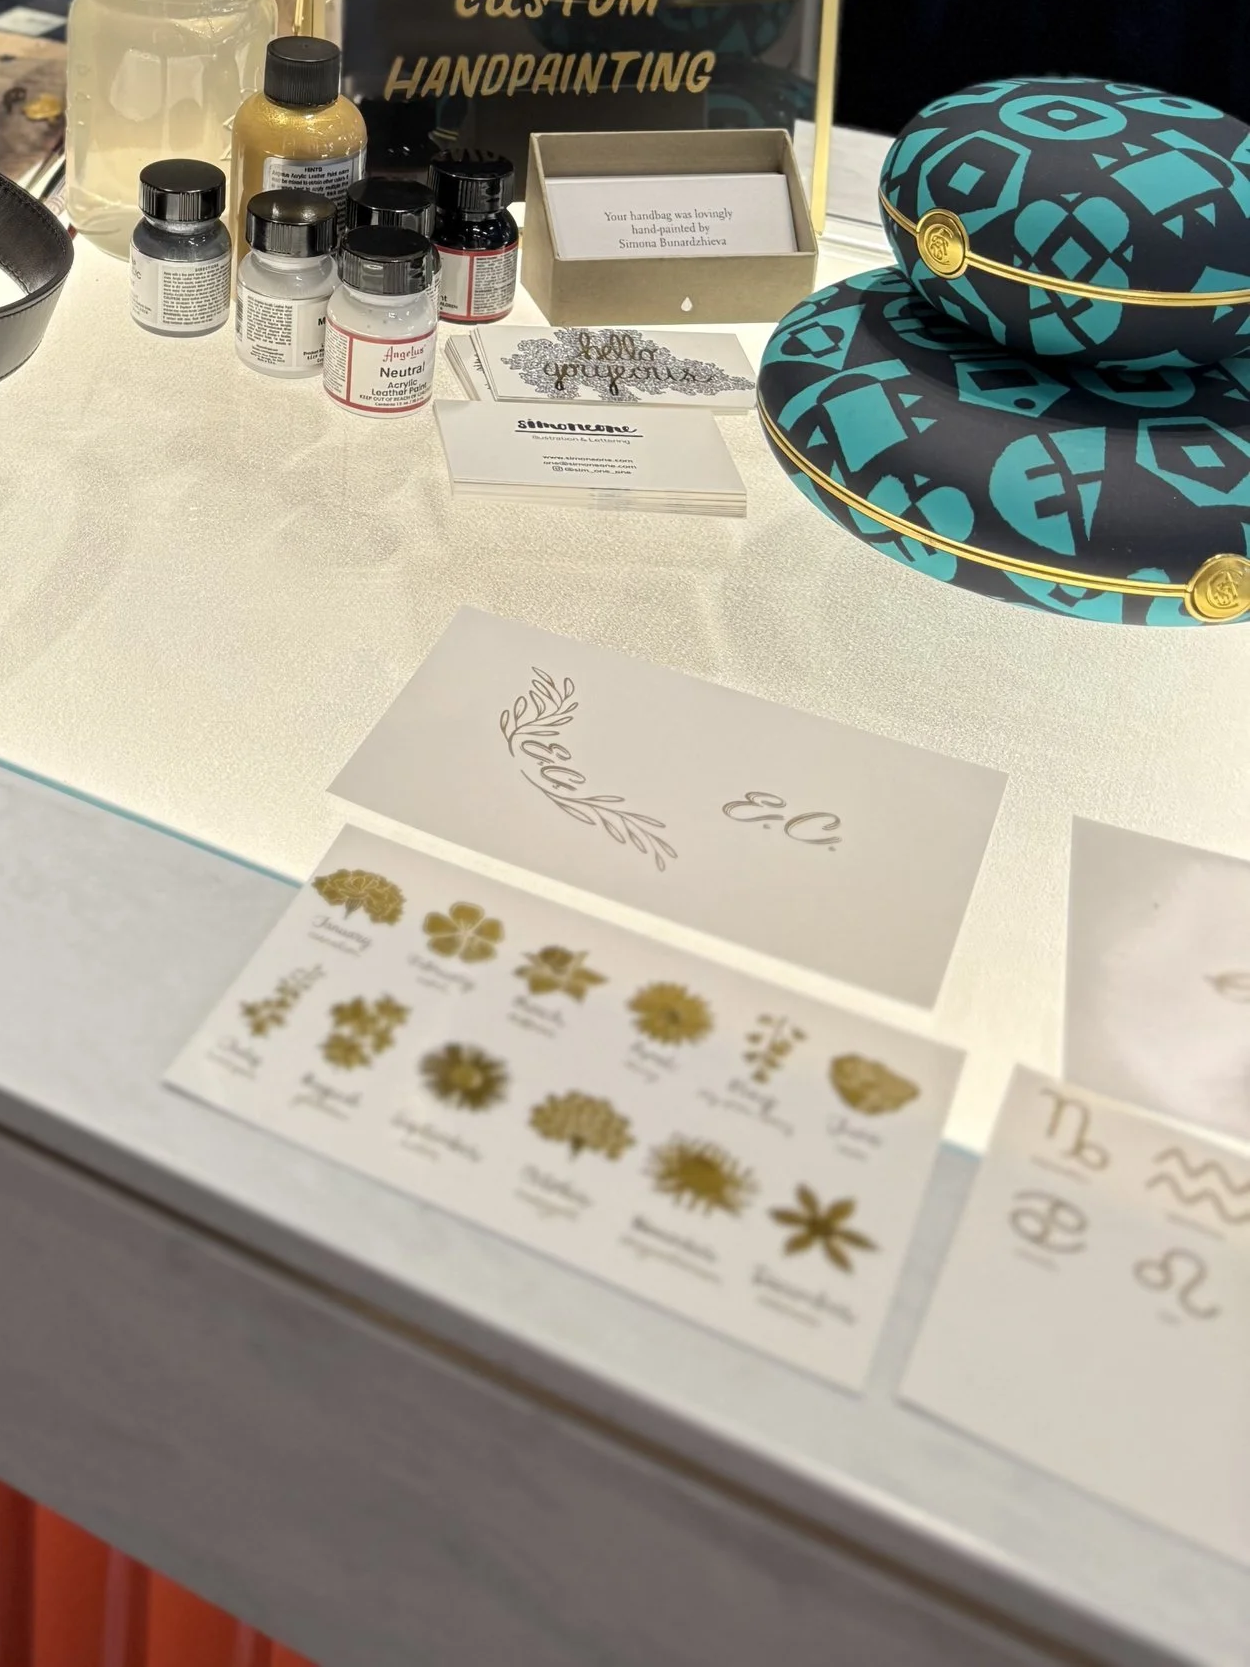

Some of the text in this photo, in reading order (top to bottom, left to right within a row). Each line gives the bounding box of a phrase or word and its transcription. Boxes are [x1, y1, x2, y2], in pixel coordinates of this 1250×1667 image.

[383, 49, 717, 102] HANDPAINTING
[604, 207, 733, 222] Your handbag was lovingly
[631, 222, 710, 236] hand-painted by
[618, 236, 727, 249] Simona Bunardzhieva
[382, 345, 424, 363] Angelus
[577, 332, 657, 362] hello
[380, 361, 426, 378] Neutral
[388, 379, 418, 390] Acrylic
[543, 361, 713, 396] gorgeous
[371, 388, 408, 397] Leather
[409, 382, 427, 395] Paint
[588, 437, 631, 445] Lettering
[311, 914, 373, 951] January
